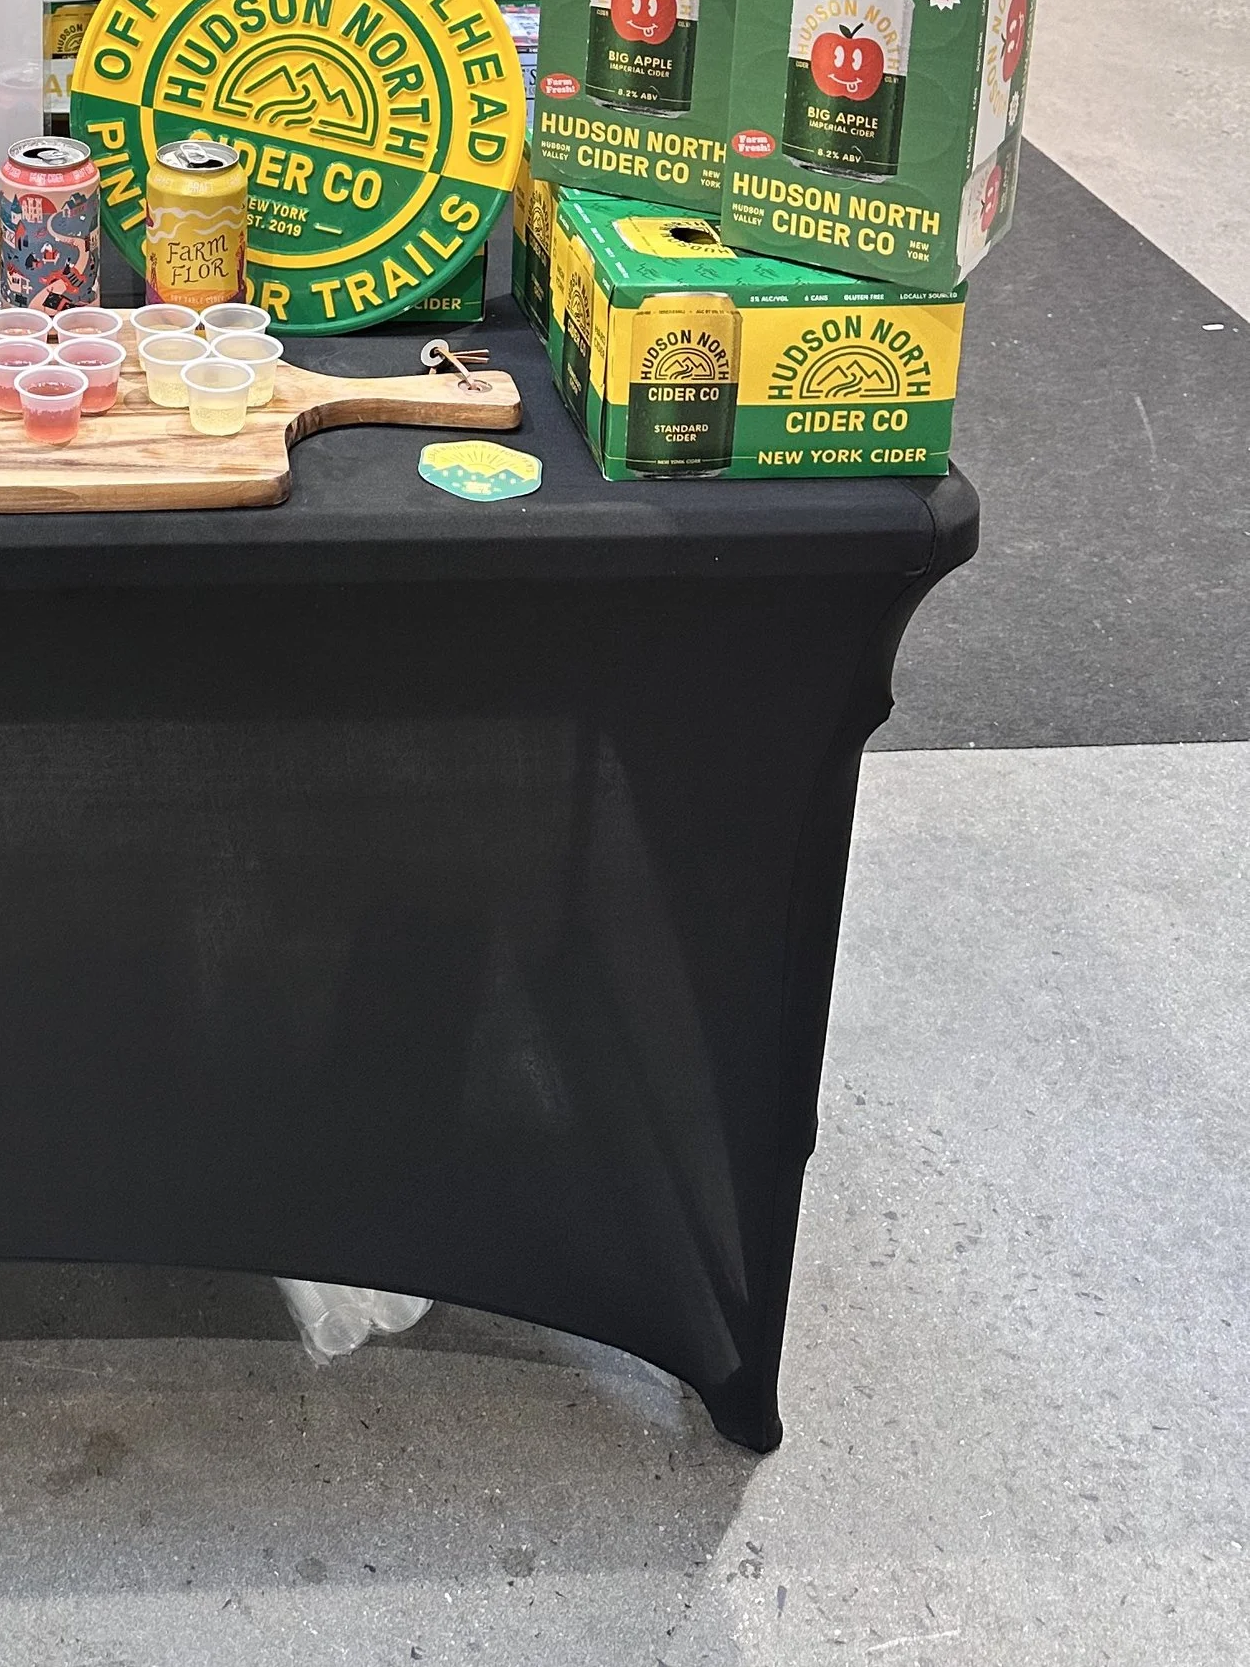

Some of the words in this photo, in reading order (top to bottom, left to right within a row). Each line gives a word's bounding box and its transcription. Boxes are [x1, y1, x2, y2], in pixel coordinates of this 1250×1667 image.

[798, 0, 858, 54] HUDSON
[864, 5, 899, 71] NORTH
[341, 3, 430, 159] NORTH
[808, 107, 830, 120] BIG
[836, 113, 878, 129] APPLE
[810, 120, 848, 134] IMPERIAL
[850, 128, 875, 138] CIDER
[541, 112, 640, 149] HUDSON
[647, 131, 727, 164] NORTH
[738, 143, 770, 152] Fresh!
[86, 118, 147, 236] PINT
[577, 146, 649, 178] CIDER
[656, 160, 690, 184] CO
[322, 162, 382, 210] CO
[247, 196, 269, 212] EW
[272, 200, 308, 221] YORK
[732, 203, 764, 216] HUDSON
[733, 172, 841, 215] HUDSON
[849, 196, 940, 236] NORTH
[247, 214, 266, 229] ST.
[268, 218, 302, 237] 2019
[733, 214, 762, 226] VALLEY
[772, 210, 850, 248] CIDER
[858, 228, 895, 256] CO
[311, 194, 480, 319] TRAILS
[907, 250, 930, 262] YORK
[910, 240, 929, 251] NEW
[172, 260, 229, 285] FLOR
[641, 330, 692, 381] HUDSON
[697, 332, 730, 381] NORTH
[768, 315, 862, 400] HUDSON
[870, 318, 931, 397] NORTH
[648, 388, 696, 402] CIDER
[700, 386, 720, 401] CO
[654, 424, 709, 434] STANDARD
[786, 410, 865, 434] CIDER
[872, 410, 908, 432] CO
[665, 434, 697, 442] CIDER
[757, 450, 806, 465] NEW
[810, 449, 863, 464] YORK
[870, 448, 927, 462] CIDER
